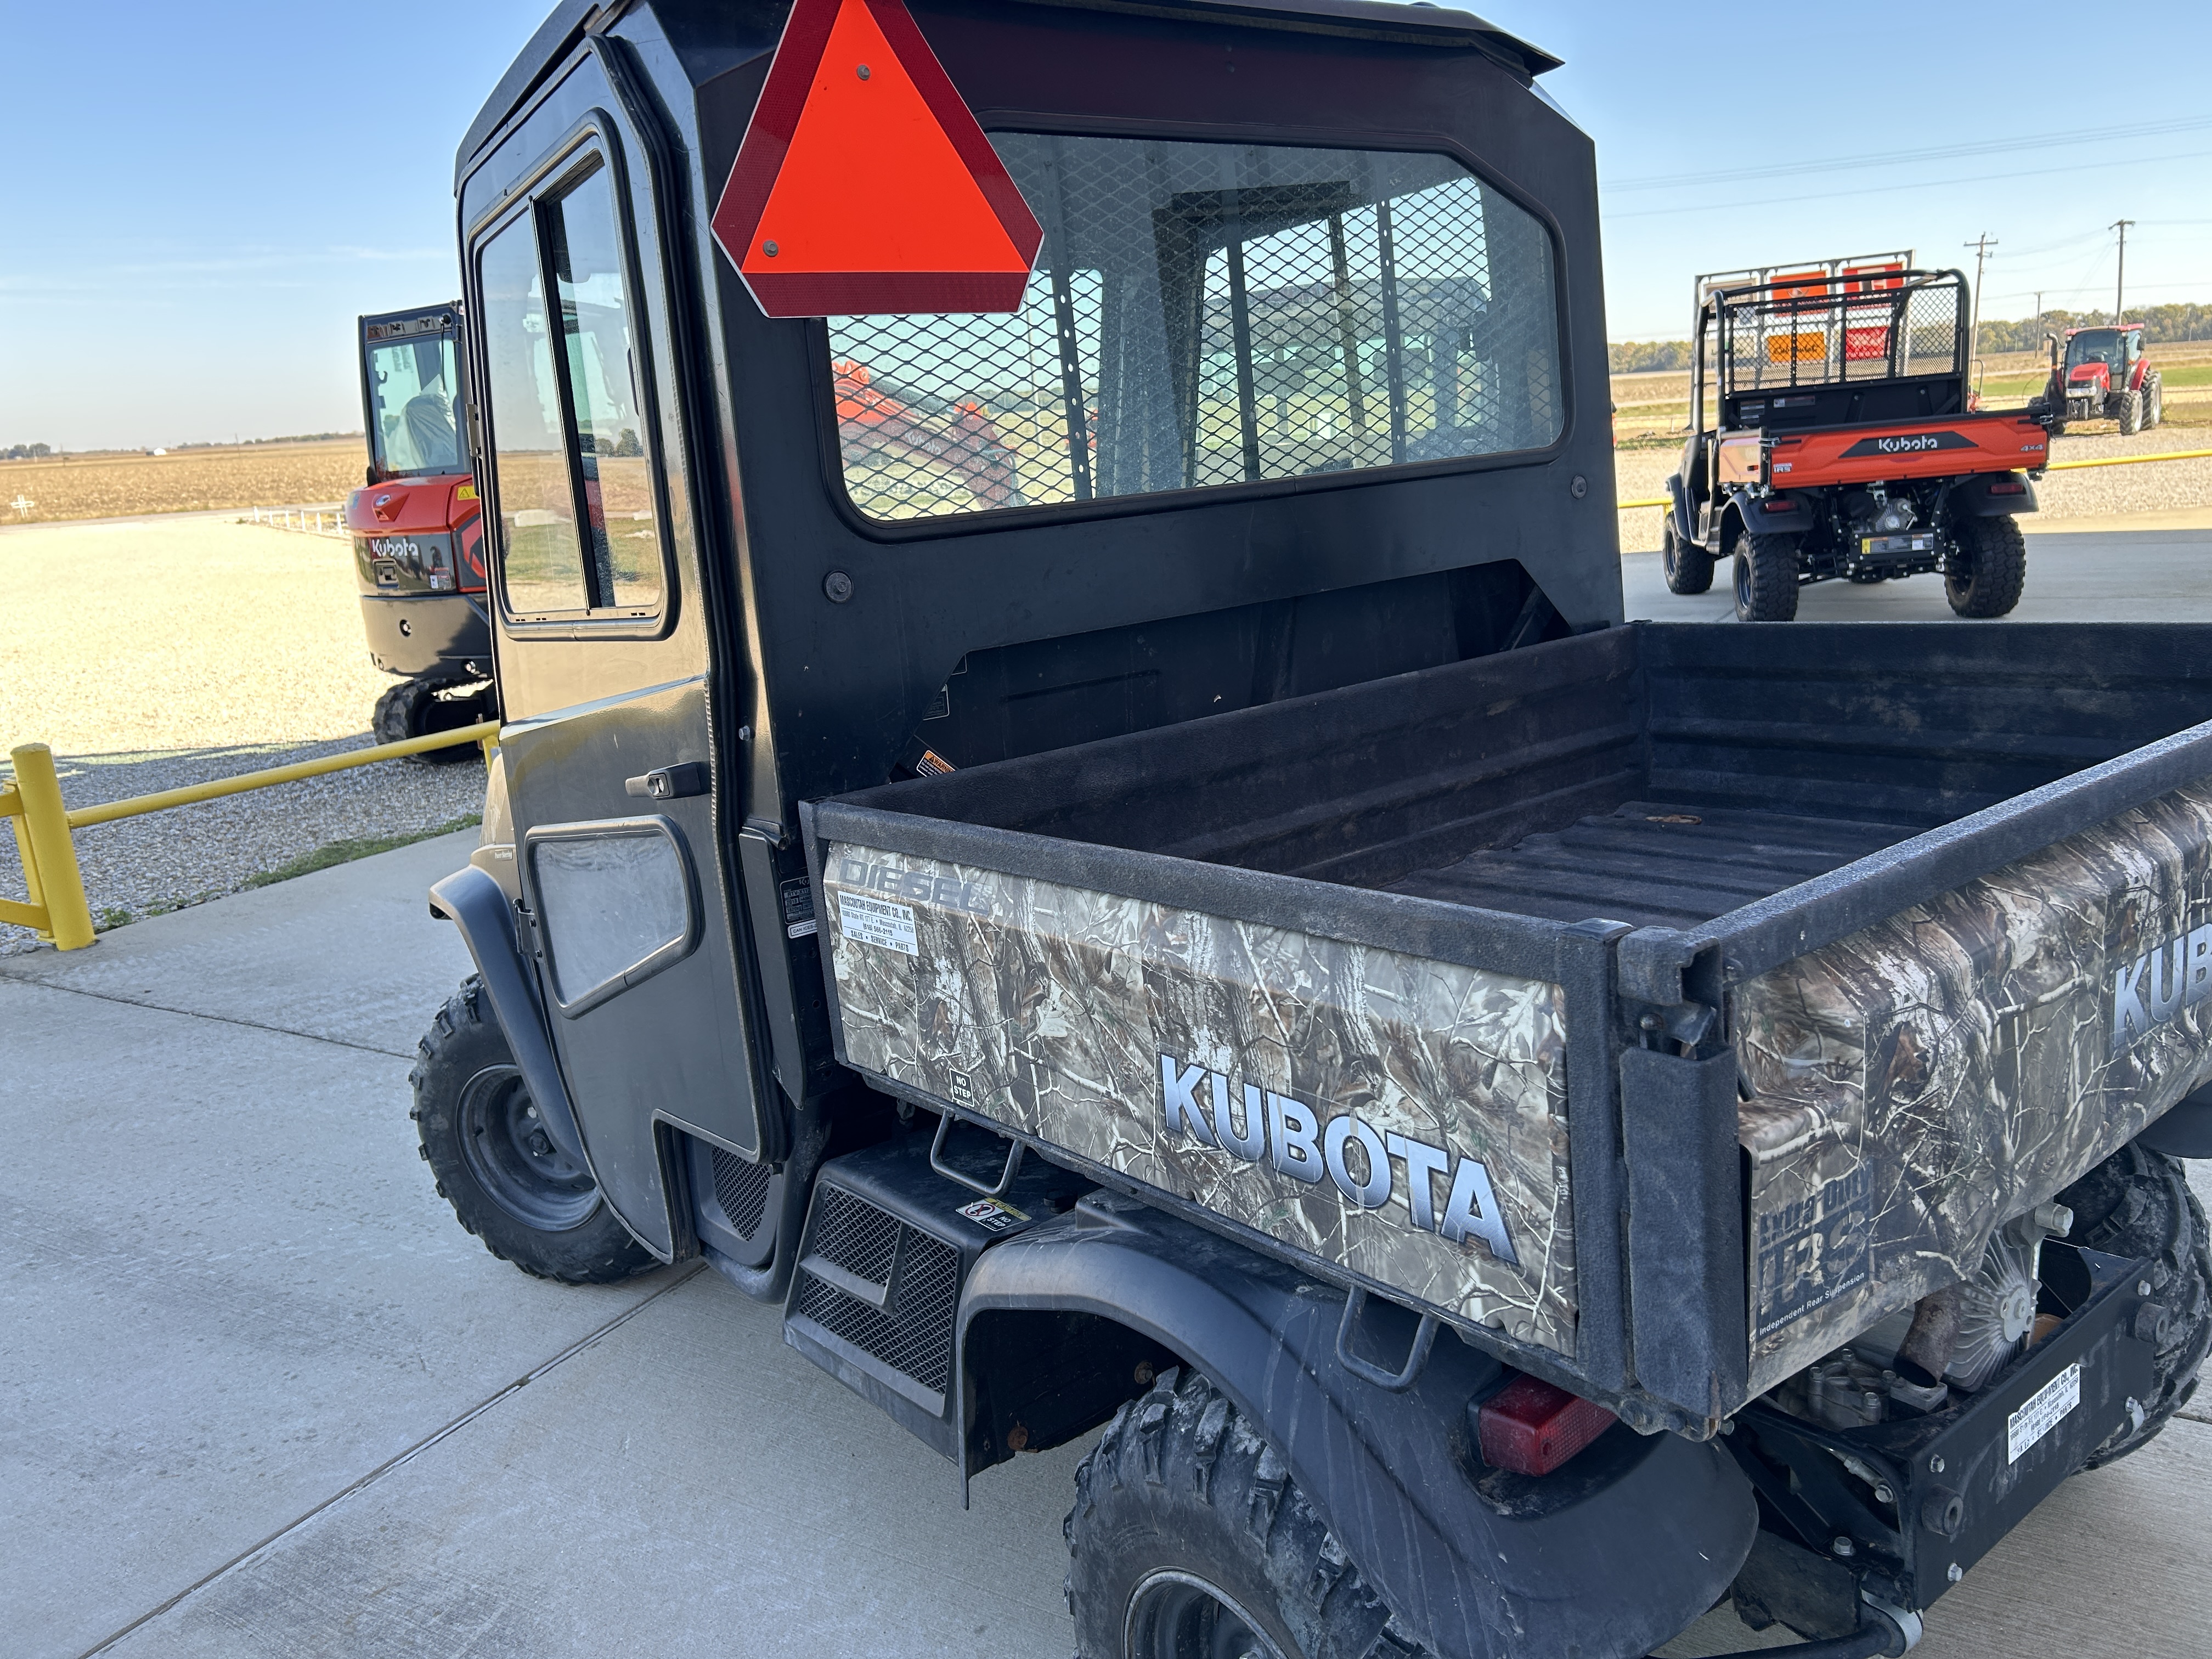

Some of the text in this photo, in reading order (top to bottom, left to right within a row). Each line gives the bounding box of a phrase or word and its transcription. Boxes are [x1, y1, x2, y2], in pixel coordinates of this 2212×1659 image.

[1878, 435, 1938, 452] Kubota
[372, 538, 418, 557] Kubota
[839, 859, 990, 915] DIESEL
[839, 894, 866, 911] MASCOUTAH
[866, 901, 891, 917] EQUIPMENT
[902, 909, 912, 922] INC.
[850, 930, 909, 952] SALES SERVICE PARTS
[956, 1075, 967, 1087] NO
[953, 1085, 972, 1099] STEP
[1160, 1052, 1519, 1265] KUBOTA
[986, 1217, 1006, 1227] STEP
[1759, 1271, 1865, 1336] Independent Rear Suspension
[2059, 1401, 2072, 1418] PARTS
